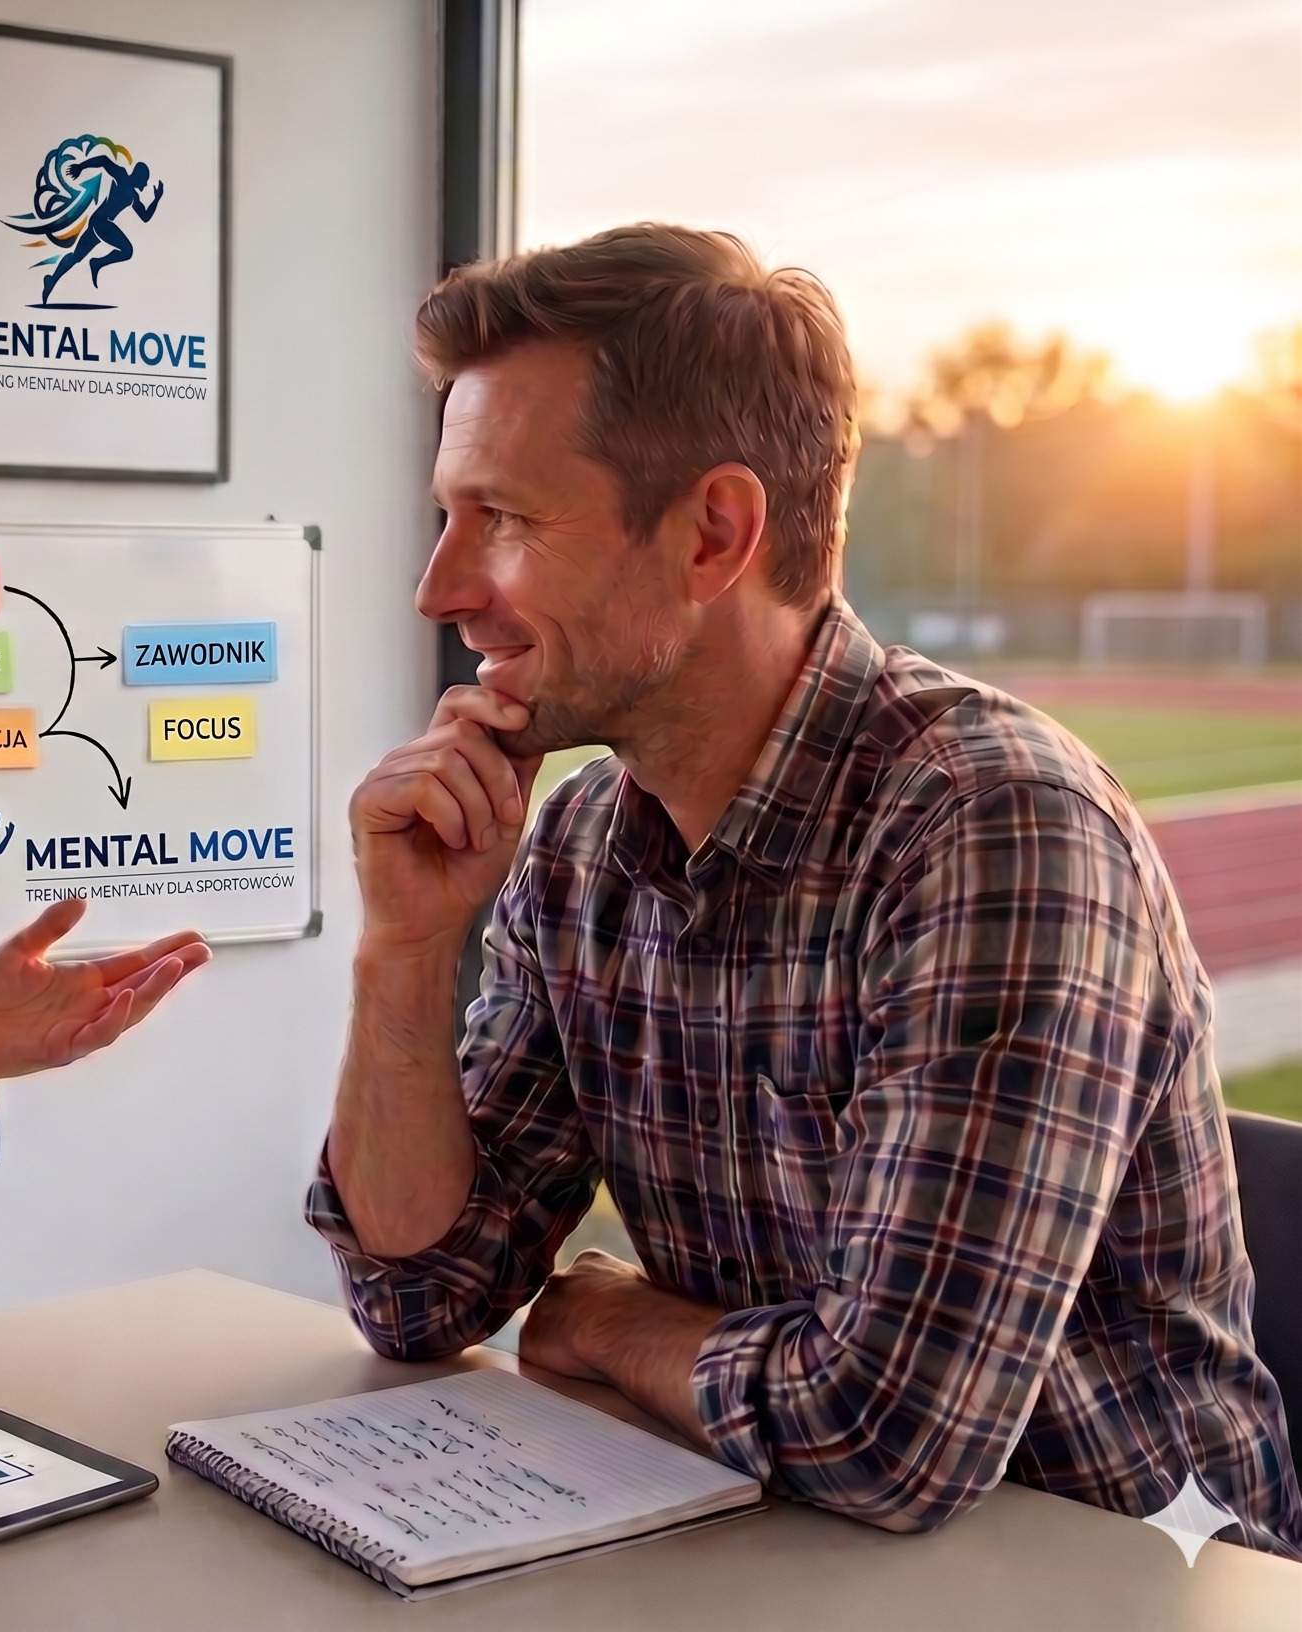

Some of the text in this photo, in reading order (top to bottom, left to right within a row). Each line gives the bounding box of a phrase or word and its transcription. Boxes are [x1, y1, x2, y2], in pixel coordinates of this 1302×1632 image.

[109, 329, 207, 369] MOVE
[17, 375, 86, 393] MENTALNY
[88, 380, 114, 396] DLA
[115, 382, 207, 401] SPORTOWCÓW
[135, 640, 266, 668] ZAWODNIK
[163, 716, 241, 741] FOCUS
[25, 827, 295, 872] MENTAL MOVE
[25, 873, 296, 902] TRENING MENTALNY DLA SPORTOWCÓW
